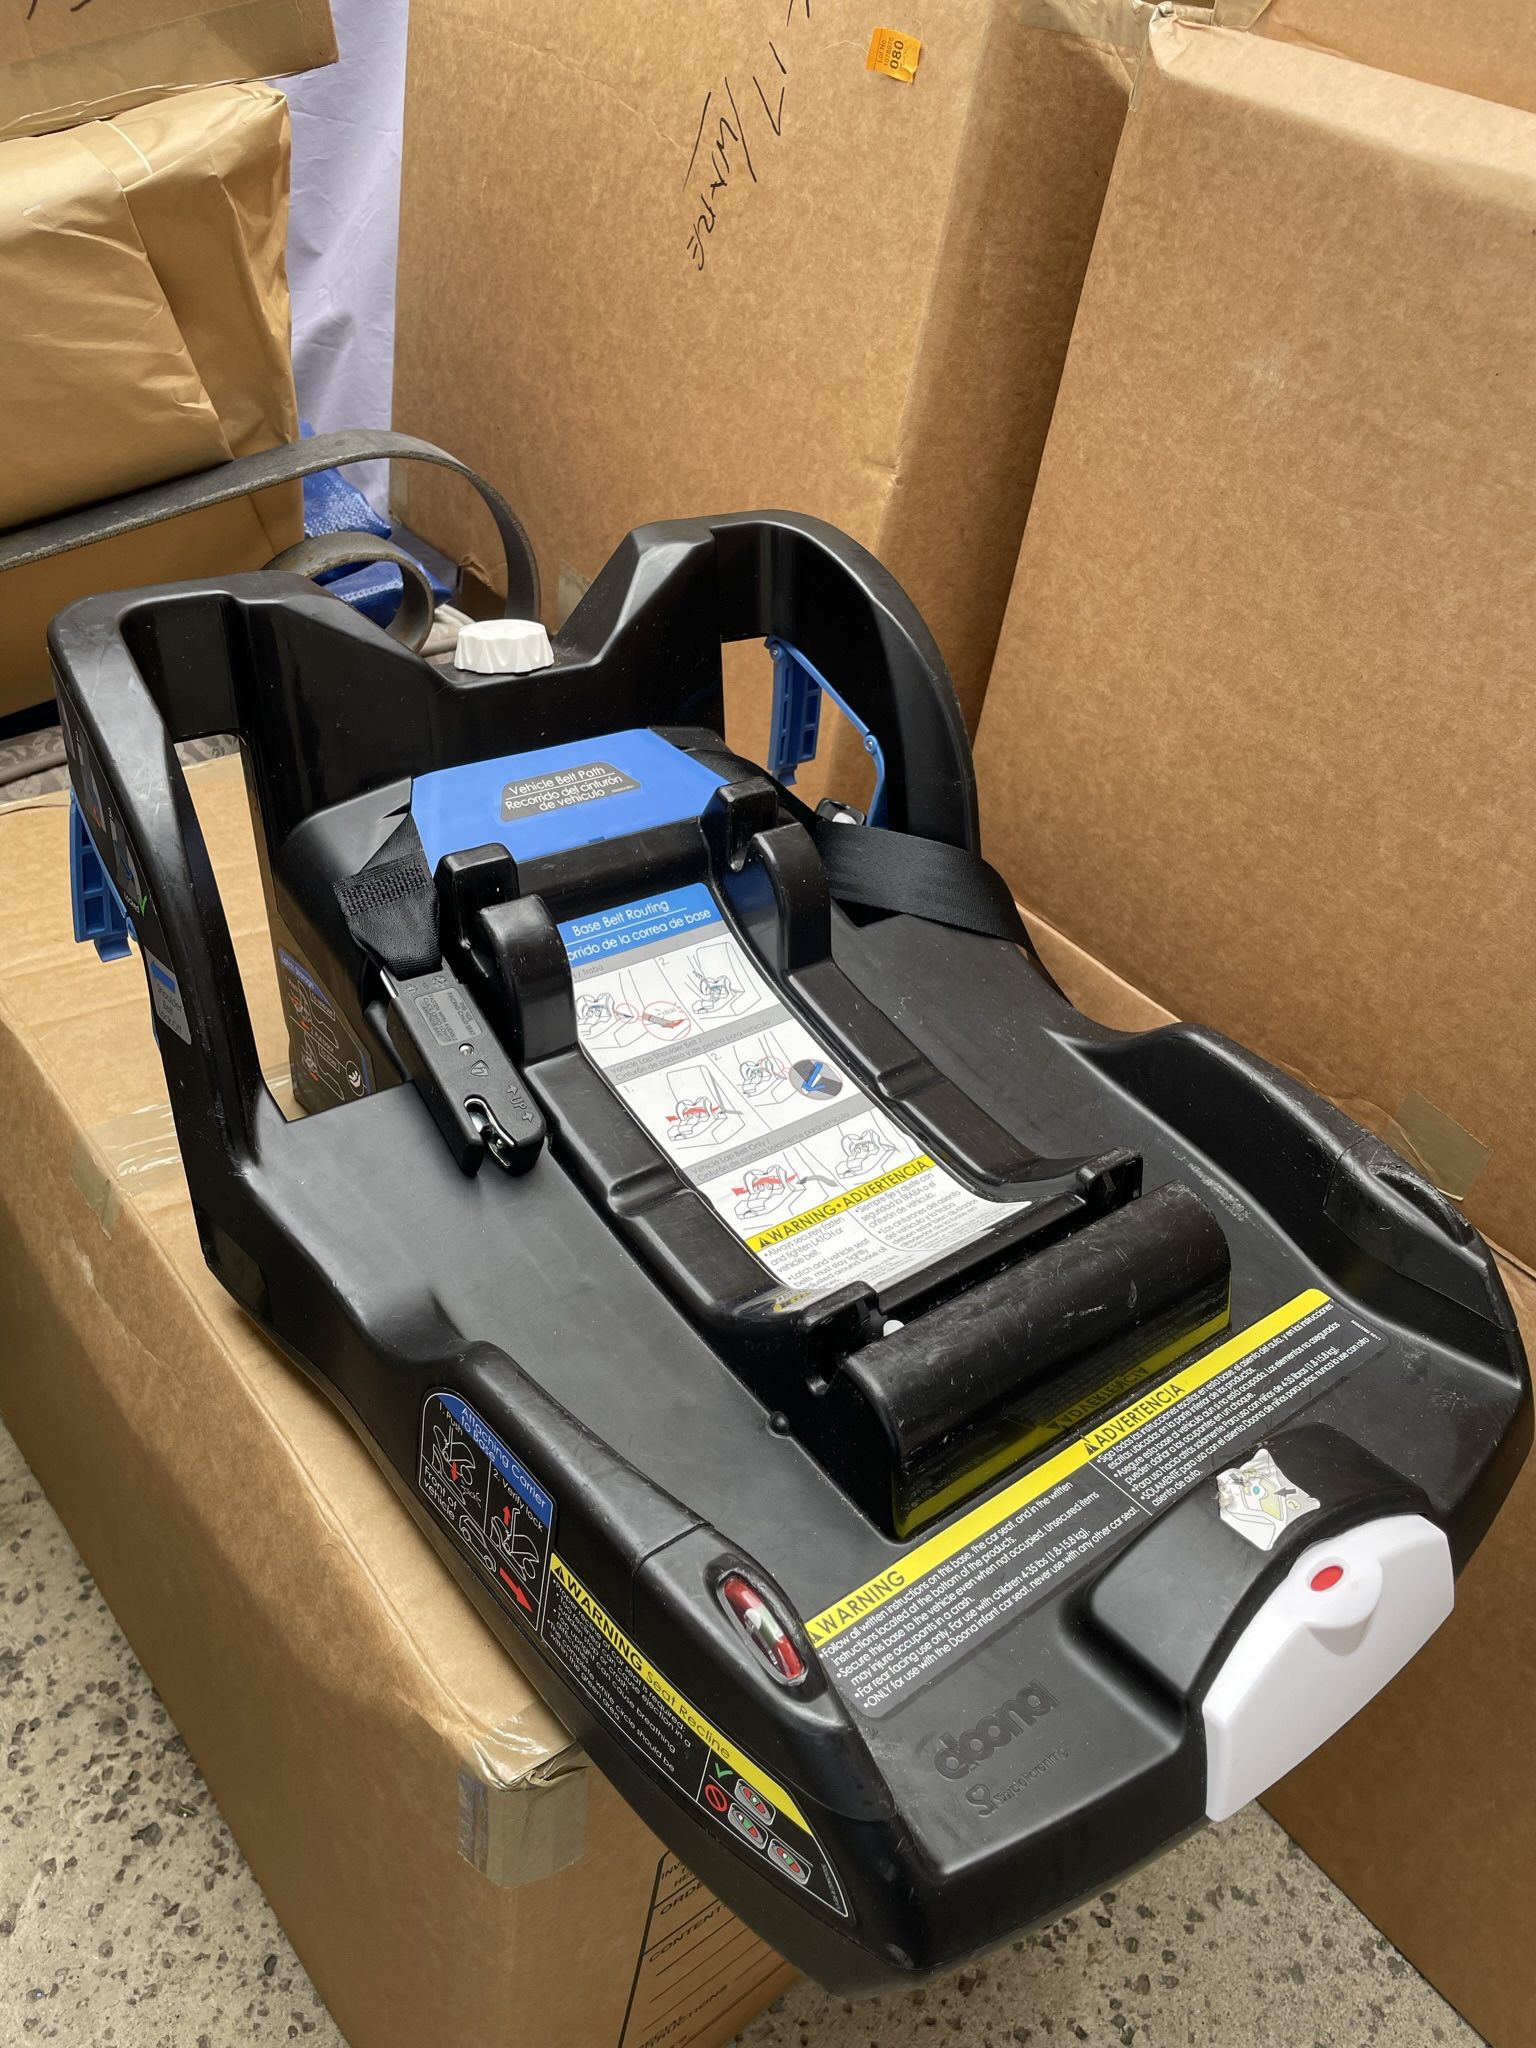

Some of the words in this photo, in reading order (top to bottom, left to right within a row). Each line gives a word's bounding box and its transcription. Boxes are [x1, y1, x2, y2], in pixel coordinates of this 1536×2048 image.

[890, 40, 904, 69] 080
[505, 789, 559, 810] Recorrido
[560, 785, 579, 797] del
[579, 773, 622, 792] cinturón
[509, 778, 554, 796] Vehicle
[554, 772, 577, 785] Belt
[577, 765, 605, 779] Path
[538, 800, 556, 811] de
[567, 944, 600, 961] orrido
[602, 937, 617, 950] de
[619, 934, 630, 944] la
[632, 924, 668, 940] correa
[669, 917, 684, 929] de
[685, 909, 711, 924] base
[572, 922, 600, 936] Base
[602, 914, 624, 927] Belt
[626, 901, 669, 920] Routing
[510, 1097, 528, 1111] UP
[766, 1203, 839, 1242] WARNING
[838, 1159, 930, 1207] ADVERTENCIA
[445, 1410, 463, 1436] Push
[460, 1415, 471, 1434] to
[472, 1428, 496, 1463] Base
[1091, 1381, 1185, 1447] ADVERTENCIA
[1123, 1462, 1153, 1485] pueden
[1149, 1449, 1170, 1466] dañar
[1173, 1439, 1185, 1449] los
[1181, 1417, 1216, 1444] ocupantes
[1229, 1389, 1256, 1411] choque.
[424, 1465, 445, 1497] Front
[447, 1493, 456, 1511] of
[461, 1405, 509, 1469] Attaching
[510, 1462, 547, 1511] Carrier
[1150, 1486, 1176, 1506] asiento
[1182, 1466, 1203, 1483] auto.
[423, 1477, 455, 1522] vehicle
[501, 1478, 524, 1511] Verify
[525, 1506, 543, 1533] lock
[821, 1633, 850, 1658] Follow
[847, 1626, 861, 1639] all
[857, 1607, 888, 1633] written
[884, 1579, 929, 1614] instructions
[937, 1562, 953, 1577] this
[950, 1548, 975, 1569] base,
[970, 1540, 987, 1554] the
[984, 1532, 1000, 1545] car
[996, 1519, 1017, 1537] seat,
[1013, 1508, 1032, 1524] and
[1035, 1495, 1051, 1509] the
[1046, 1480, 1073, 1501] written
[838, 1650, 871, 1677] Secure
[867, 1640, 885, 1657] this
[882, 1626, 905, 1646] base
[911, 1609, 929, 1625] the
[925, 1590, 957, 1616] vehicle
[954, 1577, 977, 1596] even
[972, 1561, 998, 1582] when
[994, 1552, 1010, 1567] not
[1007, 1527, 1048, 1559] occupied.
[1042, 1502, 1082, 1532] Unsecured
[1077, 1490, 1100, 1507] items
[816, 1568, 907, 1636] WARNING
[831, 1629, 878, 1667] instructions
[874, 1608, 909, 1636] located
[916, 1592, 933, 1607] the
[929, 1572, 961, 1597] bottom
[967, 1557, 983, 1571] the
[979, 1533, 1018, 1564] products.
[856, 1680, 874, 1697] For
[871, 1670, 891, 1687] rear
[887, 1649, 919, 1676] facing
[915, 1640, 932, 1656] use
[928, 1625, 953, 1647] only.
[948, 1616, 963, 1631] For
[961, 1608, 978, 1622] use
[974, 1594, 994, 1612] with
[990, 1573, 1023, 1600] children
[1019, 1562, 1038, 1579] 4-35
[1034, 1555, 1049, 1569] lbs
[1044, 1535, 1078, 1562] (1.8-15.8
[1072, 1525, 1092, 1542] kg).
[865, 1683, 893, 1708] ONLY
[889, 1675, 905, 1690] for
[903, 1666, 920, 1681] use
[916, 1651, 937, 1671] with
[934, 1641, 952, 1658] the
[947, 1621, 979, 1647] Doona
[975, 1606, 1000, 1628] infant
[998, 1598, 1013, 1612] car
[1010, 1583, 1032, 1602] seat,
[1029, 1569, 1052, 1589] never
[1049, 1560, 1065, 1574] use
[1061, 1547, 1080, 1564] with
[1077, 1540, 1095, 1555] any
[1089, 1525, 1112, 1543] other
[1109, 1517, 1124, 1530] car
[1119, 1504, 1140, 1521] seat.
[564, 1574, 644, 1672] WARNING
[645, 1670, 676, 1706] Seat
[677, 1704, 730, 1760] Recline
[850, 1667, 873, 1688] may
[868, 1650, 895, 1674] injure
[890, 1619, 938, 1658] occupants
[948, 1592, 975, 1615] crash.
[934, 1679, 1061, 1779] doona
